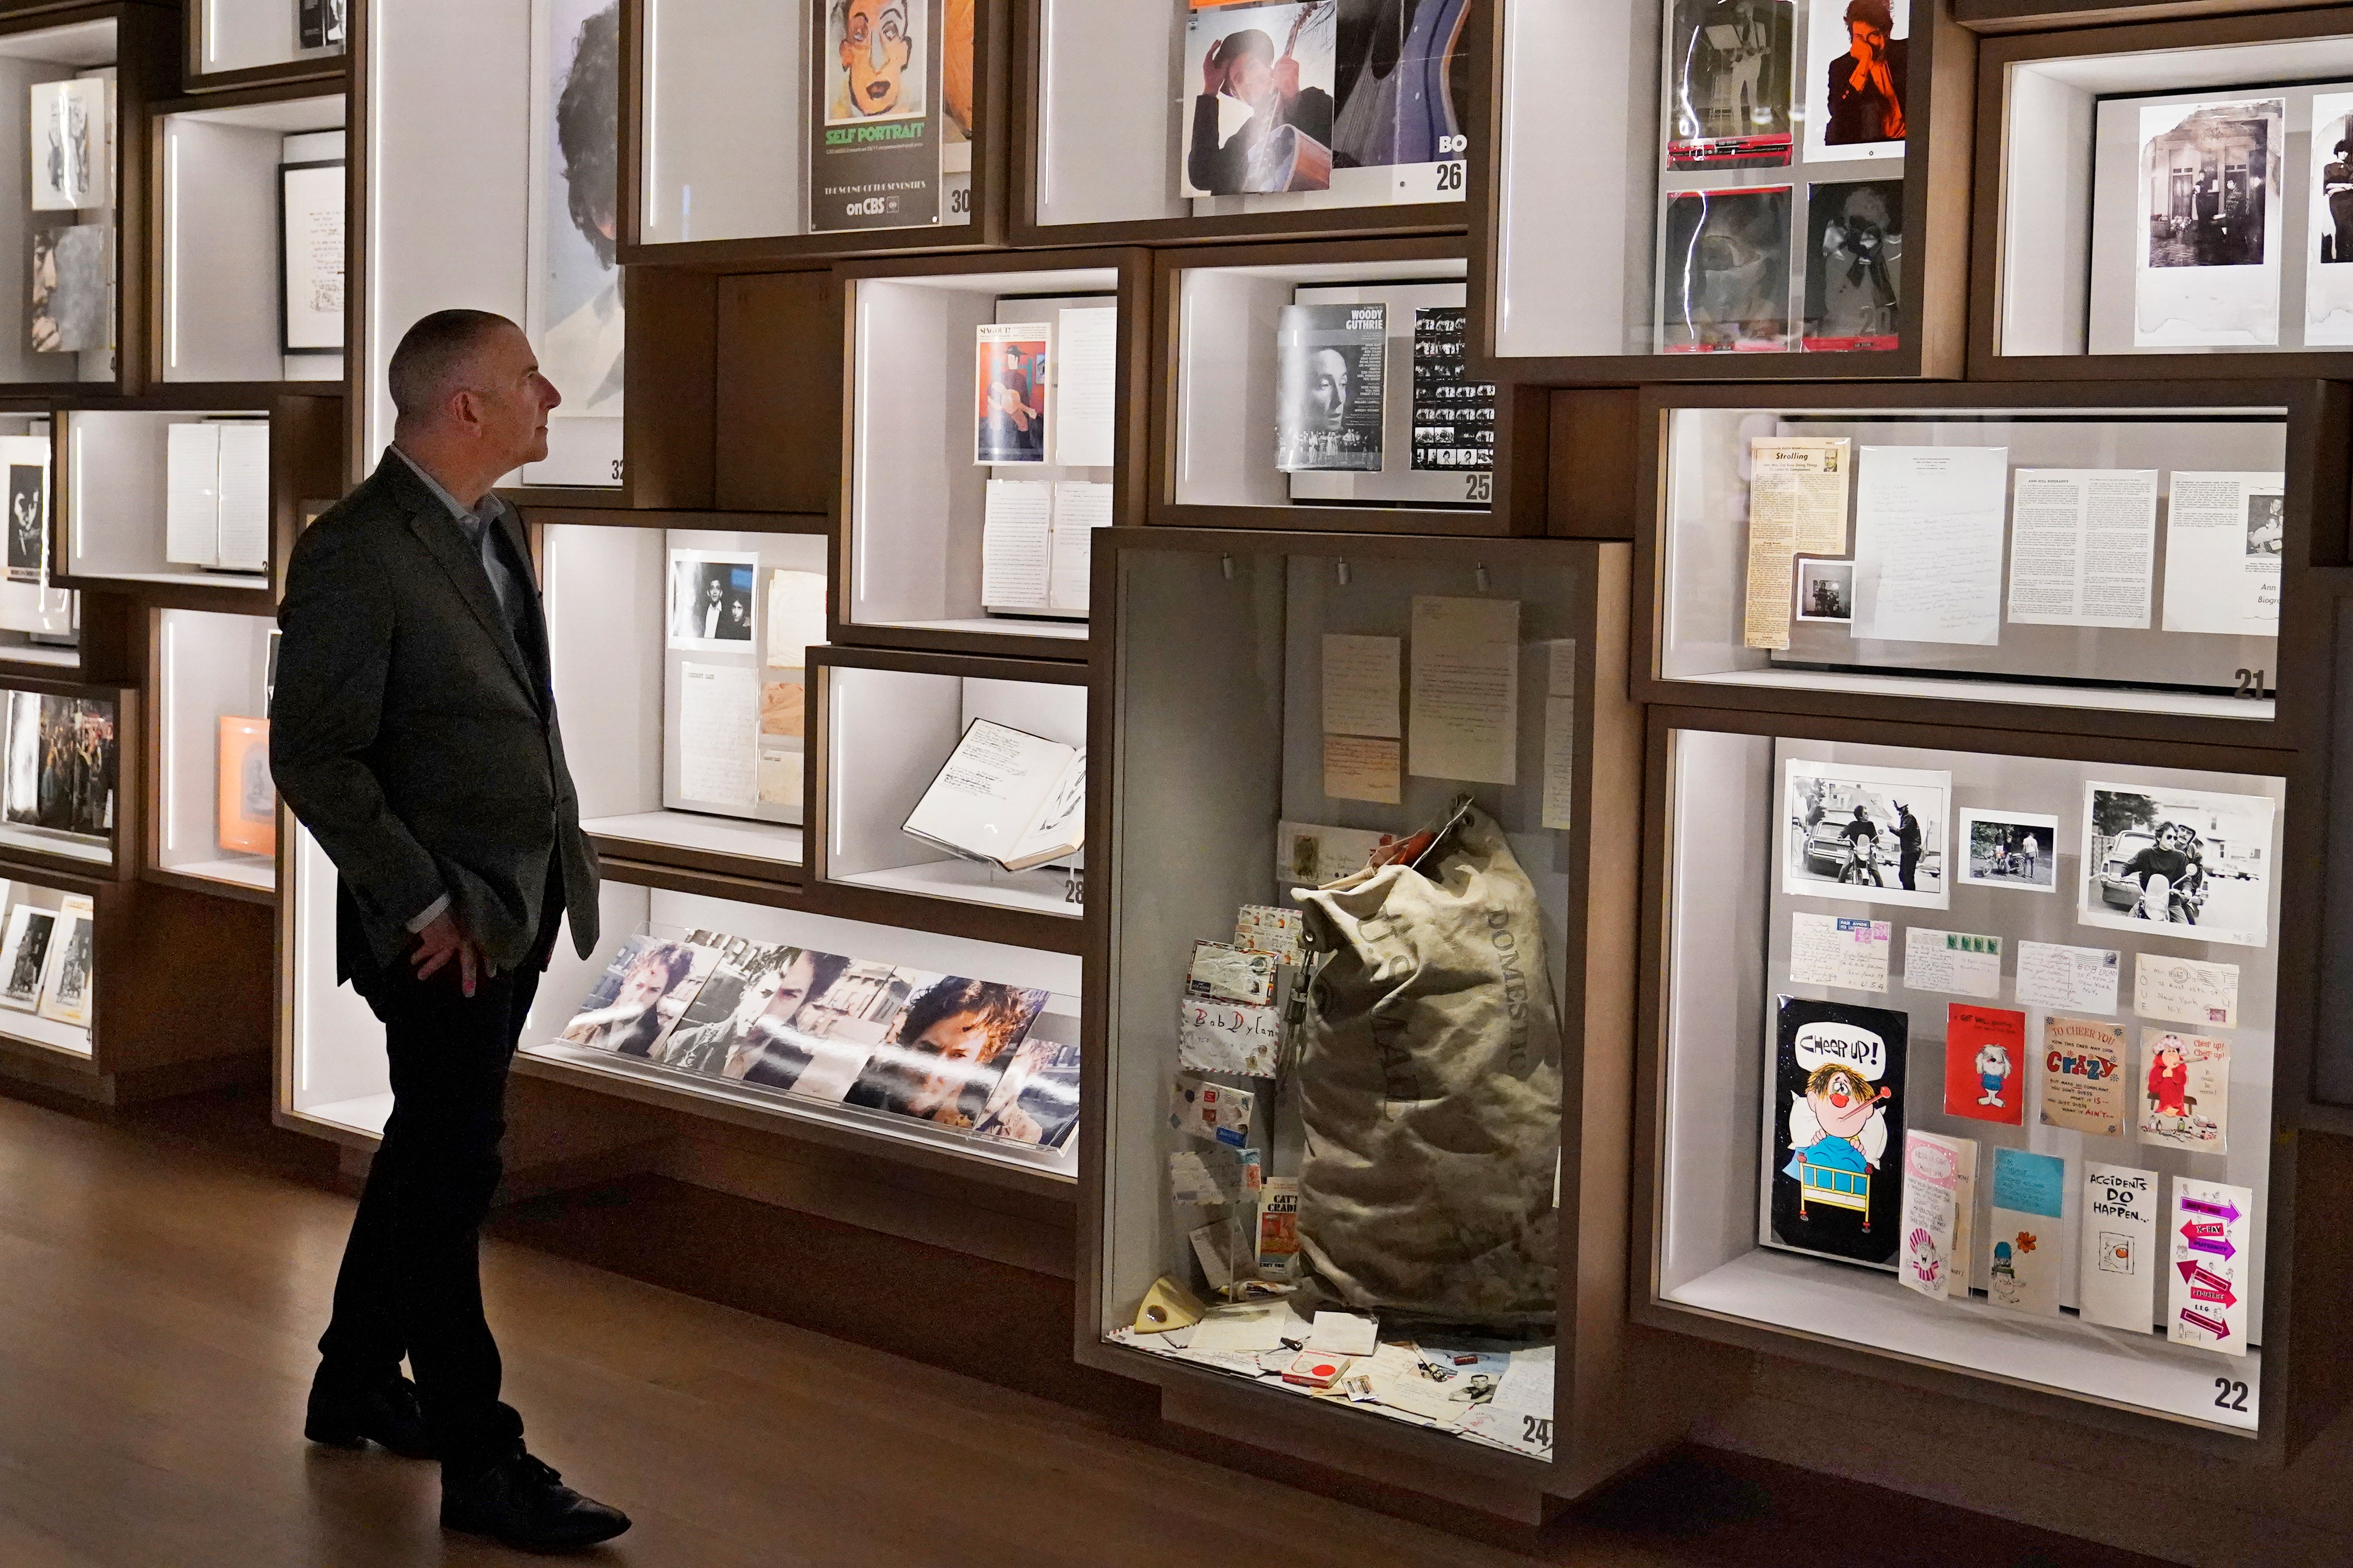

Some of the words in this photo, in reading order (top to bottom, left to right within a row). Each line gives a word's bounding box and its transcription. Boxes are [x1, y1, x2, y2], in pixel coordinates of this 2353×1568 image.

[826, 128, 857, 144] SELF
[858, 122, 924, 142] PORTRAIT
[1437, 163, 1461, 190] 26
[951, 189, 970, 213] 30
[1345, 319, 1383, 330] GUTHRIE
[1351, 309, 1383, 320] WOODY
[1776, 453, 1808, 461] Strolling
[1466, 474, 1490, 500] 25
[2235, 668, 2265, 700] 21
[1065, 879, 1085, 904] 28
[2077, 963, 2097, 974] BOB
[2099, 969, 2117, 977] DYLAN
[2158, 993, 2174, 1002] New
[2179, 995, 2198, 1006] York
[1193, 1008, 1225, 1027] Bob
[1225, 1011, 1274, 1037] Dylan
[2052, 1026, 2063, 1037] TO
[2066, 1026, 2096, 1039] CHEER
[2096, 1031, 2115, 1046] YOU
[2194, 1039, 2211, 1048] Cheer
[2213, 1043, 2224, 1051] up!
[2194, 1048, 2212, 1057] Cheer
[2214, 1053, 2224, 1061] up!
[2107, 1188, 2133, 1203] DO
[2196, 1225, 2221, 1234] X-RAY
[2214, 1377, 2248, 1412] 22
[1523, 1415, 1550, 1446] 24
